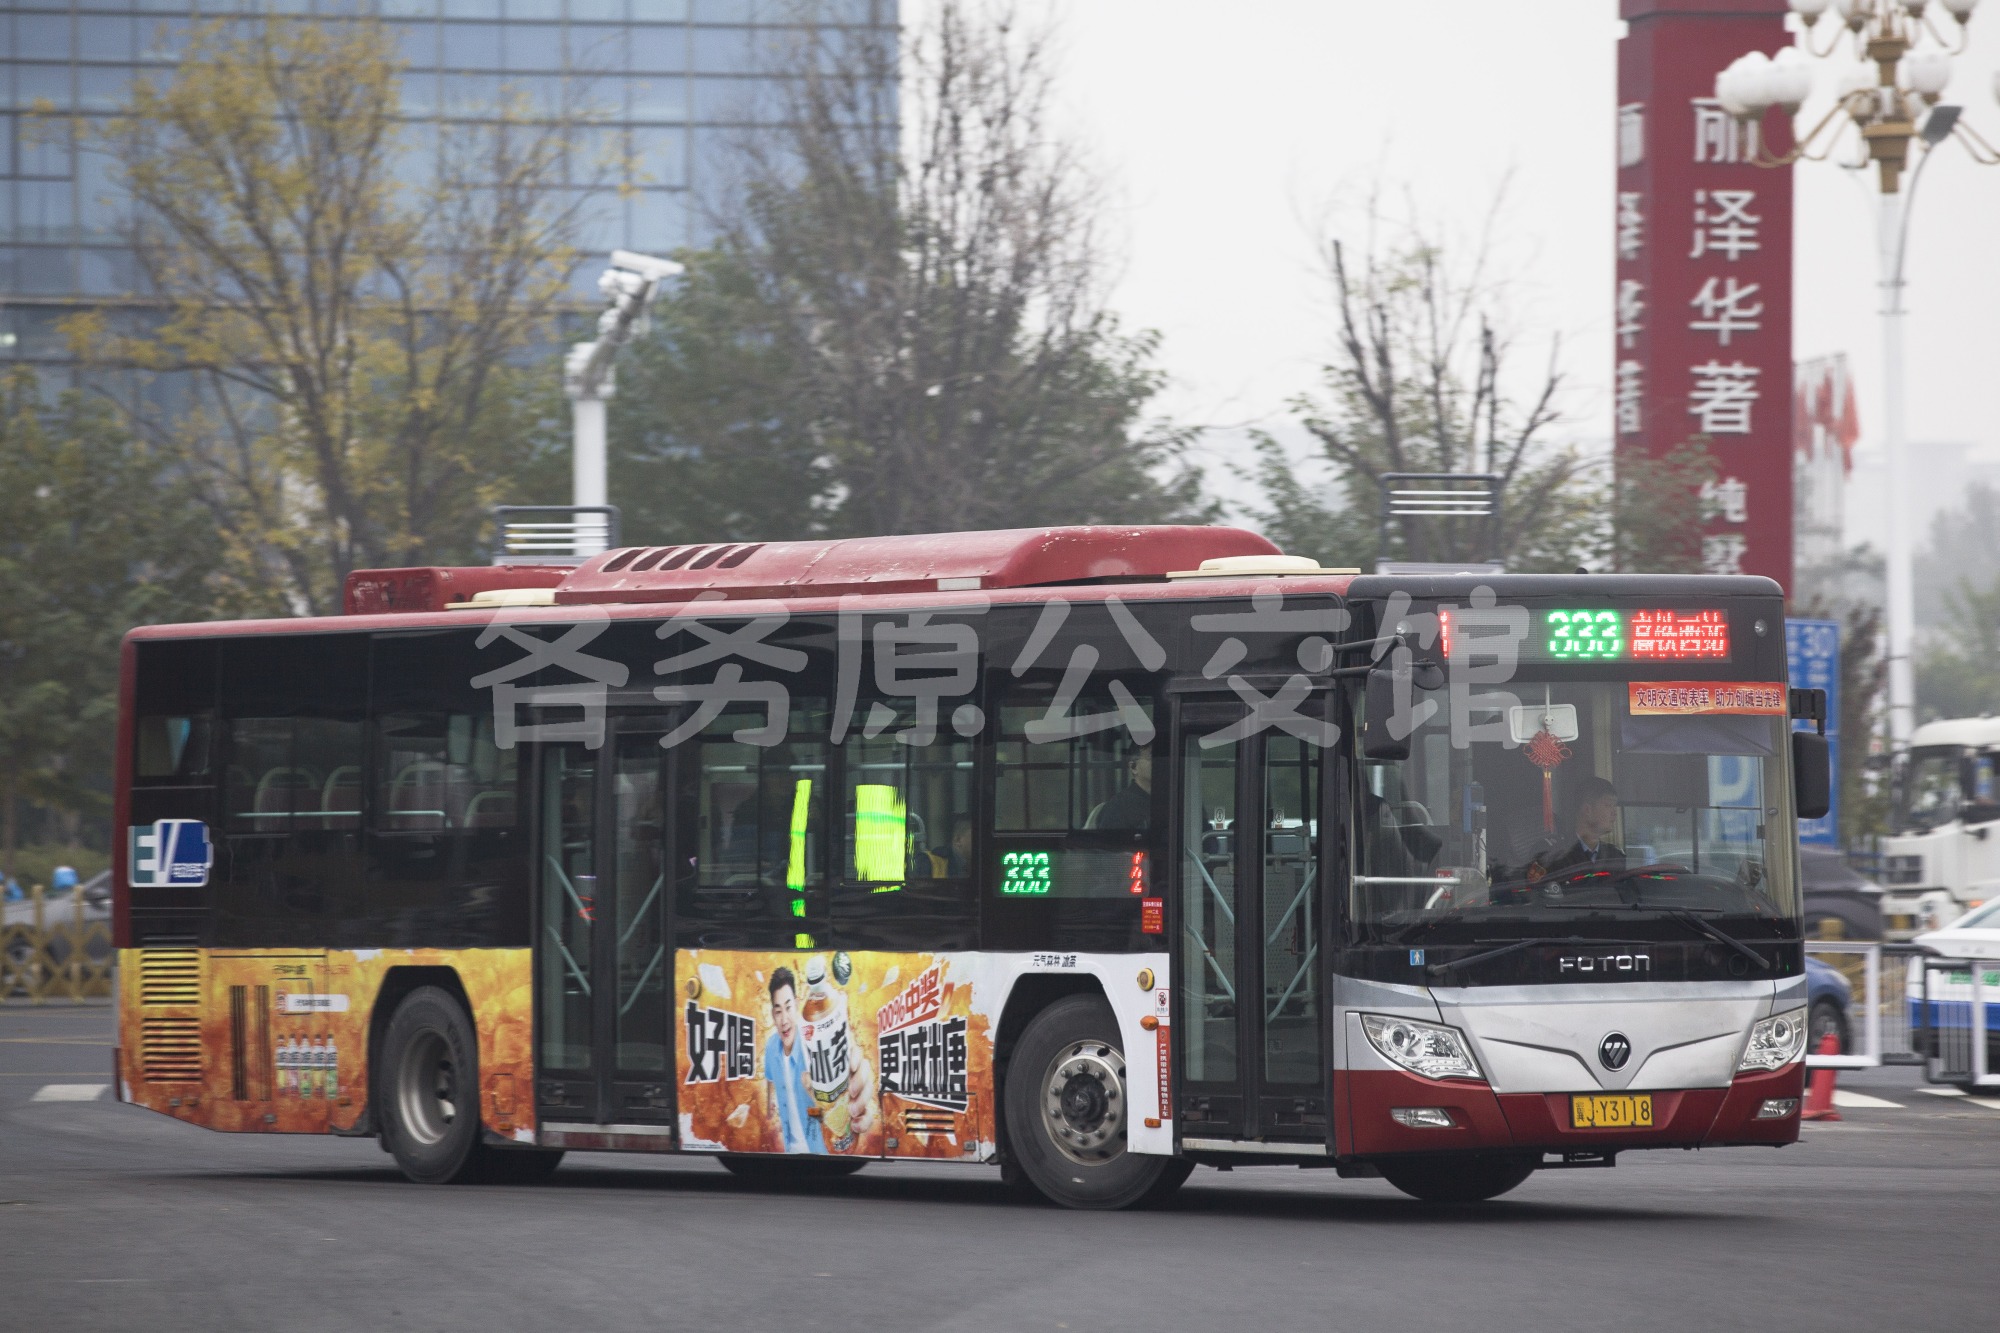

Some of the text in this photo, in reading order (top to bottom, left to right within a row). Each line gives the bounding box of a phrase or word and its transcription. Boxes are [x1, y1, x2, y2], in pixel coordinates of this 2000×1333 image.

[1689, 98, 1764, 434] 丽泽华著
[1548, 611, 1620, 657] 333
[1636, 688, 1781, 709] 文明交通做表率 助力创城当先锋
[1032, 954, 1077, 968] 元气森林 冰茶
[1560, 955, 1650, 973] FOTON
[877, 967, 940, 1033] 100%中奖
[687, 1001, 754, 1082] 好喝
[808, 1020, 848, 1084] 冰茶
[879, 1017, 967, 1102] 更减糖
